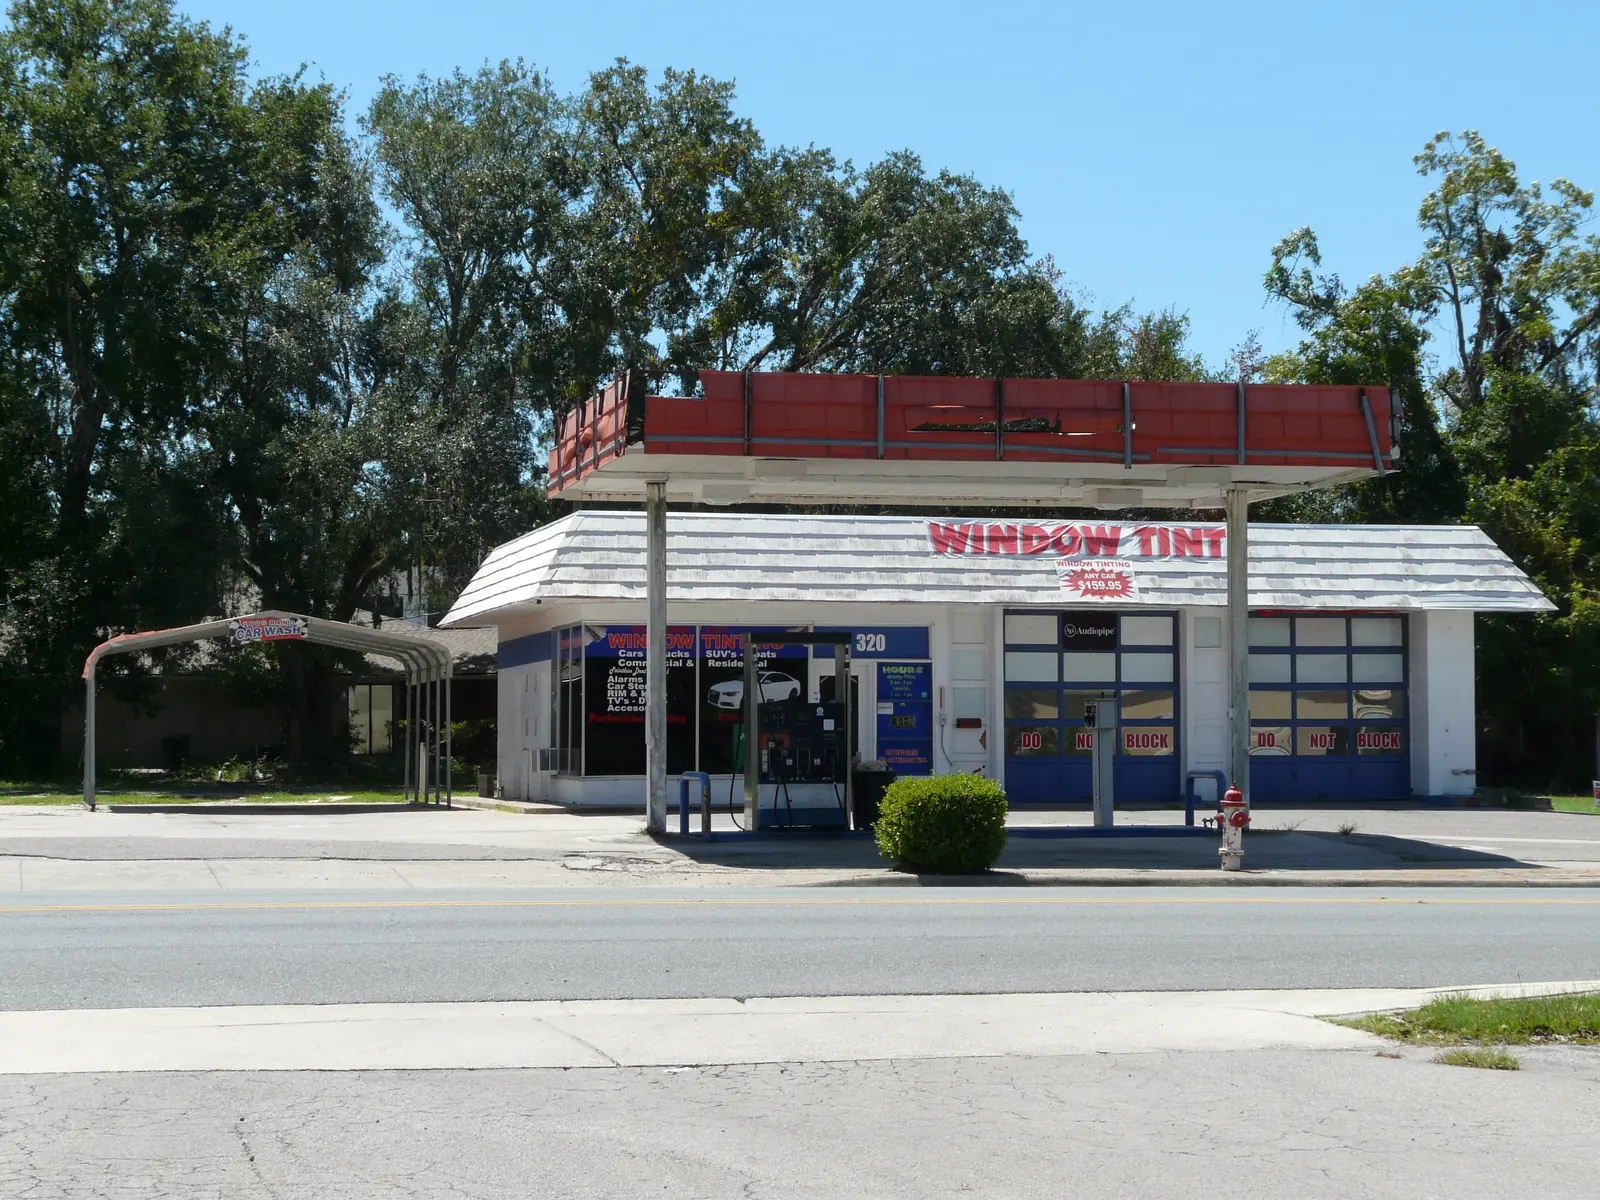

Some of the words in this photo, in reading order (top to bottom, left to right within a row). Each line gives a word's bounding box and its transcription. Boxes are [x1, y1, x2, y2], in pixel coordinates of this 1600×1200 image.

[928, 521, 1122, 556] WINDOW
[1135, 525, 1226, 558] TINT
[1056, 560, 1094, 568] WINDOW
[1095, 560, 1131, 568] TINTING
[1084, 572, 1099, 580] ANY
[1100, 572, 1116, 580] CAR
[1078, 580, 1122, 591] $159.95
[235, 627, 262, 641] CAR
[263, 626, 302, 637] WASH
[1076, 627, 1115, 636] Audiopipe
[608, 633, 695, 649] WINOW
[856, 633, 886, 652] 320
[618, 649, 643, 658] Cars
[705, 650, 737, 658] SUV's
[686, 660, 694, 668] &
[882, 665, 924, 674] HOURS
[607, 675, 644, 683] Alarms
[630, 690, 638, 698] &
[607, 697, 630, 705] TV's
[1022, 732, 1042, 750] DO
[1075, 733, 1093, 750] NO
[1126, 733, 1169, 750] BLOCK
[1257, 732, 1276, 748] DO
[1310, 733, 1336, 750] NOT
[1357, 732, 1400, 749] BLOCK
